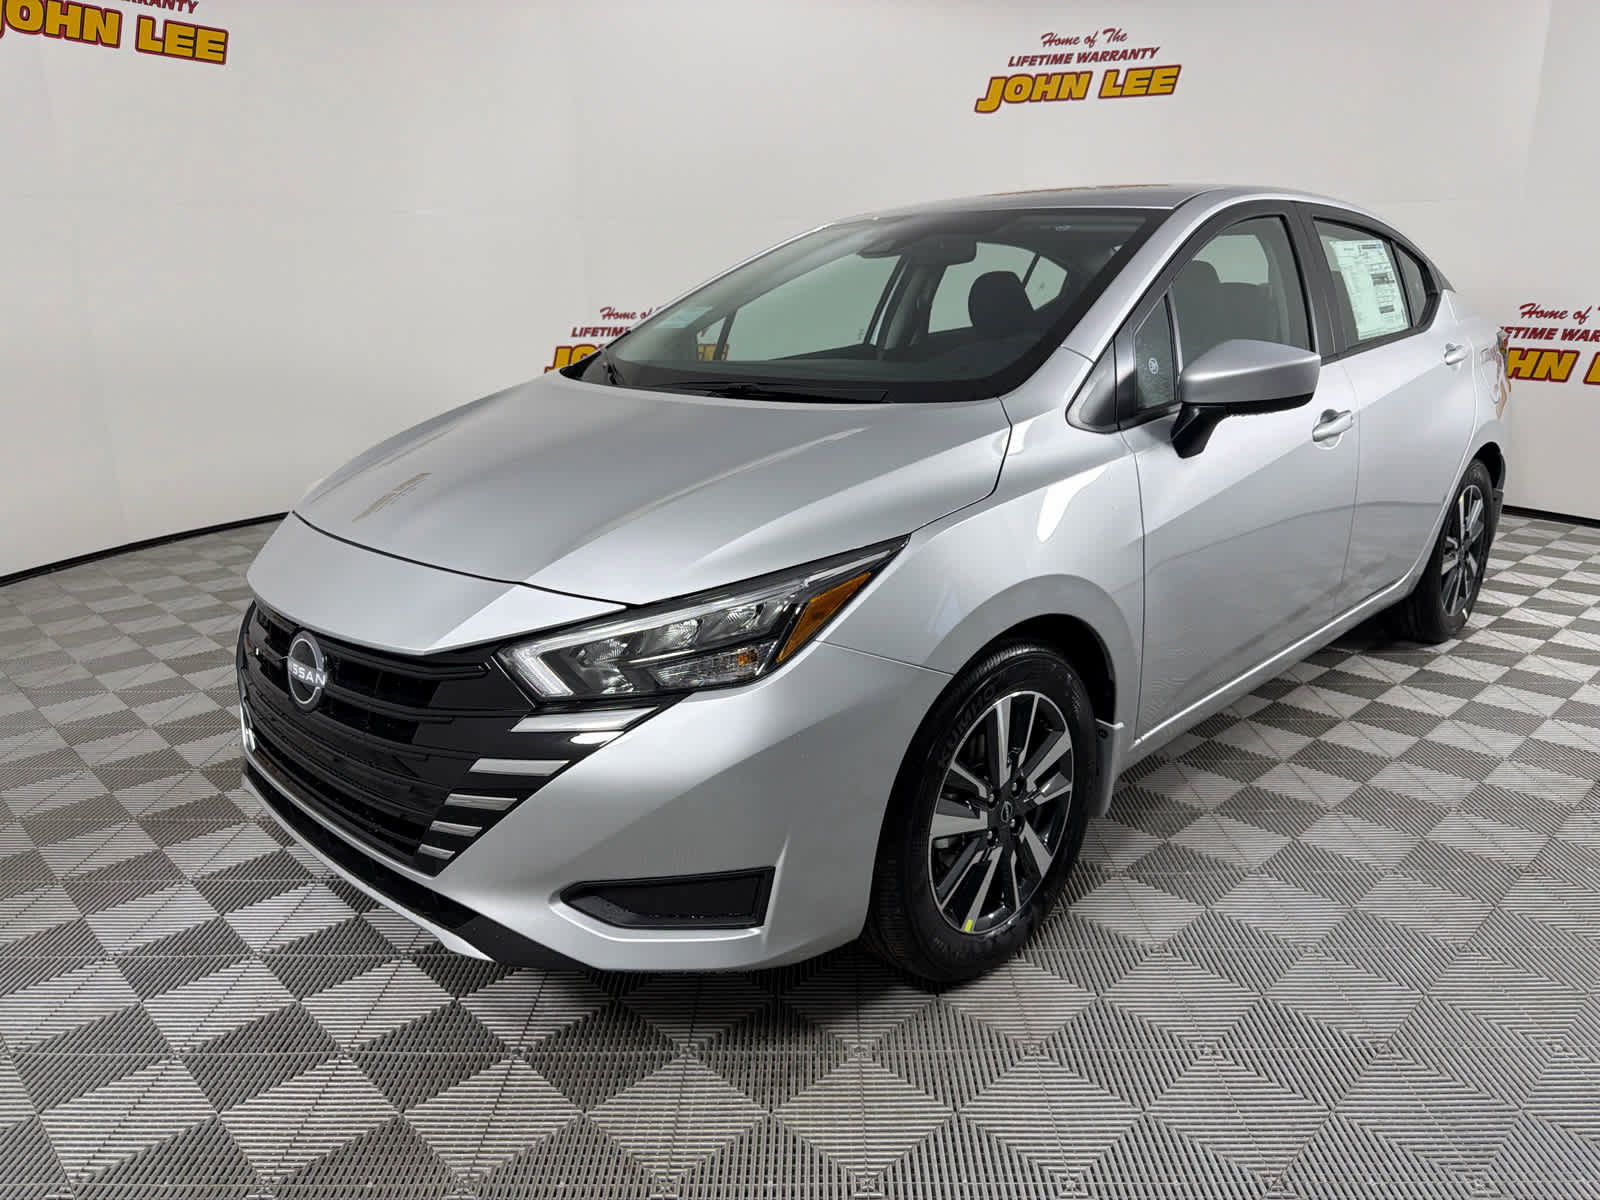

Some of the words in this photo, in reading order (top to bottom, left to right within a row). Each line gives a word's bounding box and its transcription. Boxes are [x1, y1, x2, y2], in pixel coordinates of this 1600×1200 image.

[0, 0, 122, 48] OHN
[135, 14, 229, 65] LEE
[1040, 32, 1080, 47] Home
[1084, 31, 1098, 48] of
[1102, 28, 1128, 43] The
[1008, 53, 1074, 67] LIFETIME
[1076, 47, 1160, 64] WARRANTY
[974, 70, 1093, 113] JOHN
[1098, 64, 1182, 99] LEE
[600, 306, 637, 320] Home
[1519, 303, 1568, 319] Home
[1573, 305, 1592, 325] of
[571, 326, 633, 337] LIFETIM
[1506, 347, 1580, 383] HN
